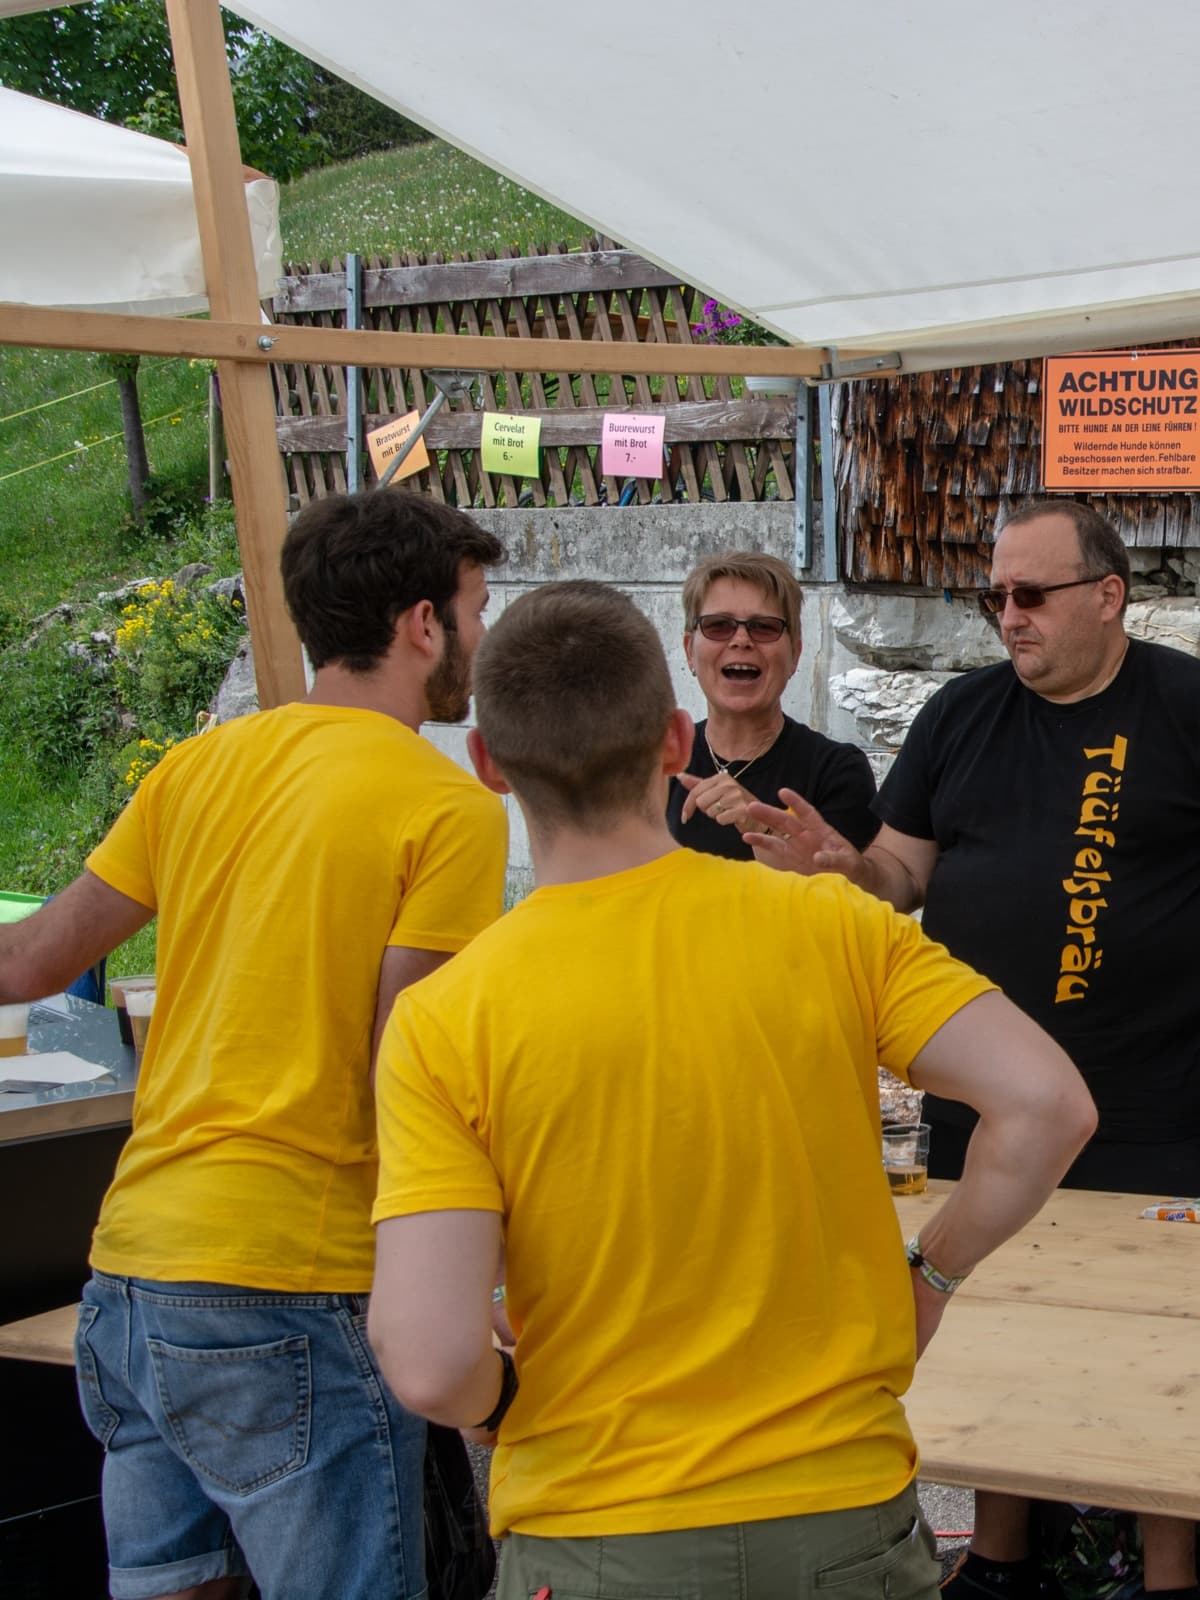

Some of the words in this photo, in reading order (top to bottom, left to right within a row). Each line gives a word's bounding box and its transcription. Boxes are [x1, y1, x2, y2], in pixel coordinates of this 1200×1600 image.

[1059, 368, 1198, 393] ACHTUNG
[1059, 396, 1197, 417] WILDSCHUTZ
[494, 422, 525, 434] Cervelat
[609, 422, 655, 434] Buurewurst
[1058, 424, 1080, 433] BITTE
[1083, 423, 1108, 433] HUNDE
[1111, 423, 1122, 433] AN
[1125, 423, 1139, 433] DER
[1142, 422, 1161, 433] LEINE
[1164, 420, 1192, 432] FÜHREN
[375, 423, 411, 447] Bratwurst
[493, 437, 505, 446] mit
[507, 437, 524, 448] Brot
[614, 437, 628, 448] mit
[630, 438, 647, 449] Brot
[1073, 441, 1118, 451] Wildernde
[1120, 441, 1147, 450] Hunde
[1149, 440, 1181, 450] können
[382, 446, 394, 459] mit
[503, 451, 513, 461] 6.-
[625, 452, 636, 463] 7.-
[1057, 454, 1122, 465] abgeschossen
[1158, 452, 1196, 462] Fehlbare
[1063, 466, 1099, 475] Besitzer
[1101, 466, 1135, 475] machen
[1136, 465, 1154, 475] sich
[1156, 465, 1192, 475] strafbar.
[1055, 734, 1128, 1003] Tüüfelsbräu
